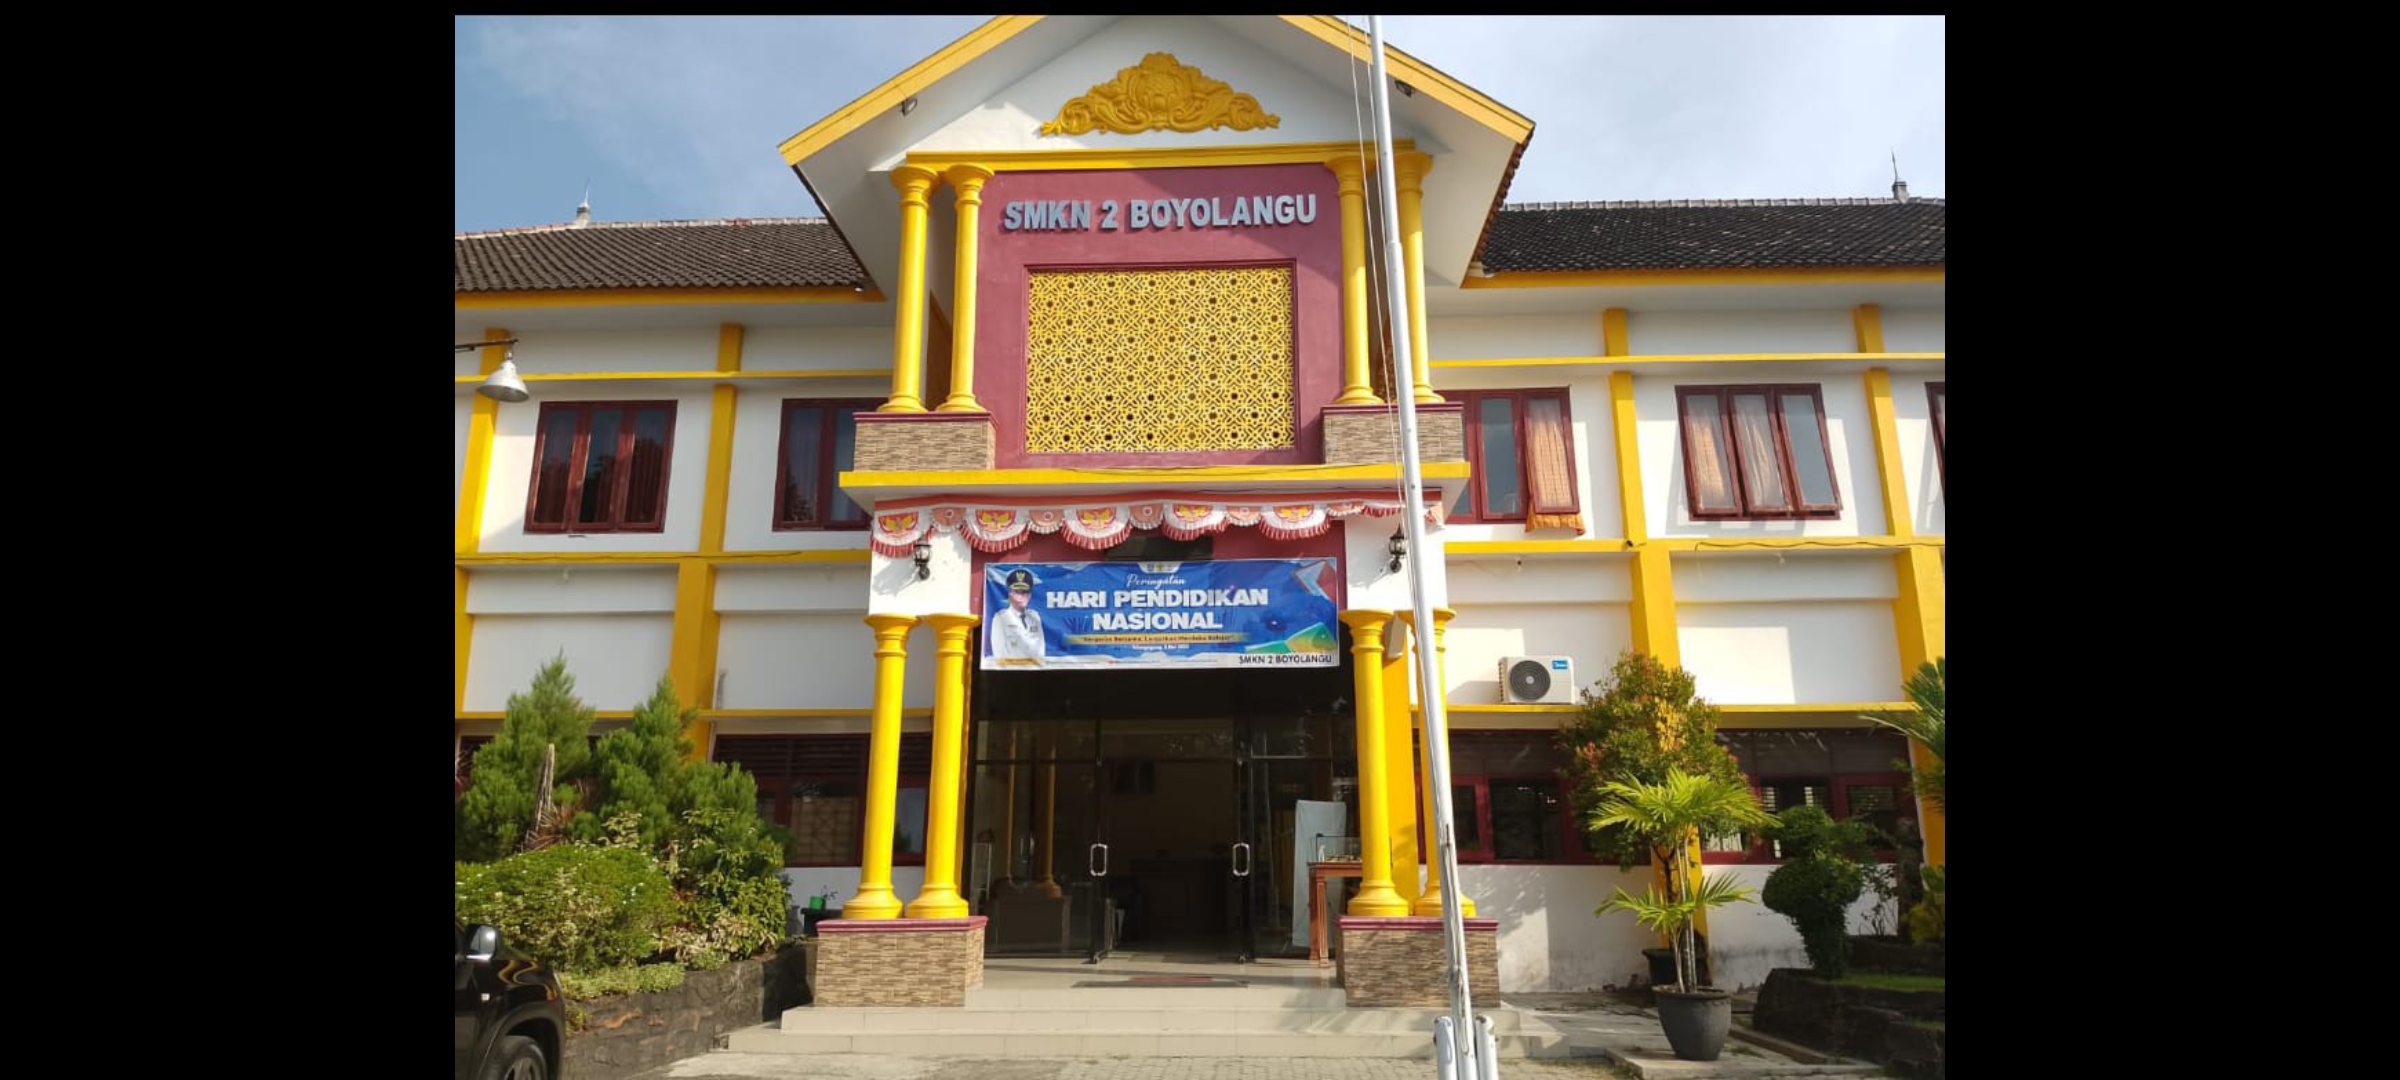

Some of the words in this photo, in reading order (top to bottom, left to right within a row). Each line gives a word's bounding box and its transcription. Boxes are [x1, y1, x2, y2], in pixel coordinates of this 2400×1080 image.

[1003, 200, 1090, 230] SMKN
[1100, 200, 1119, 229] 2
[1130, 194, 1317, 229] BOYOLANGU
[1126, 573, 1186, 590] Peringatan
[1047, 591, 1107, 608] HARI
[1114, 588, 1269, 608] PENDIDIKAN
[1092, 611, 1223, 630] NASIONAL
[1238, 654, 1265, 664] SMKN
[1267, 655, 1273, 664] 2
[1275, 654, 1332, 664] BOYOLANGU
